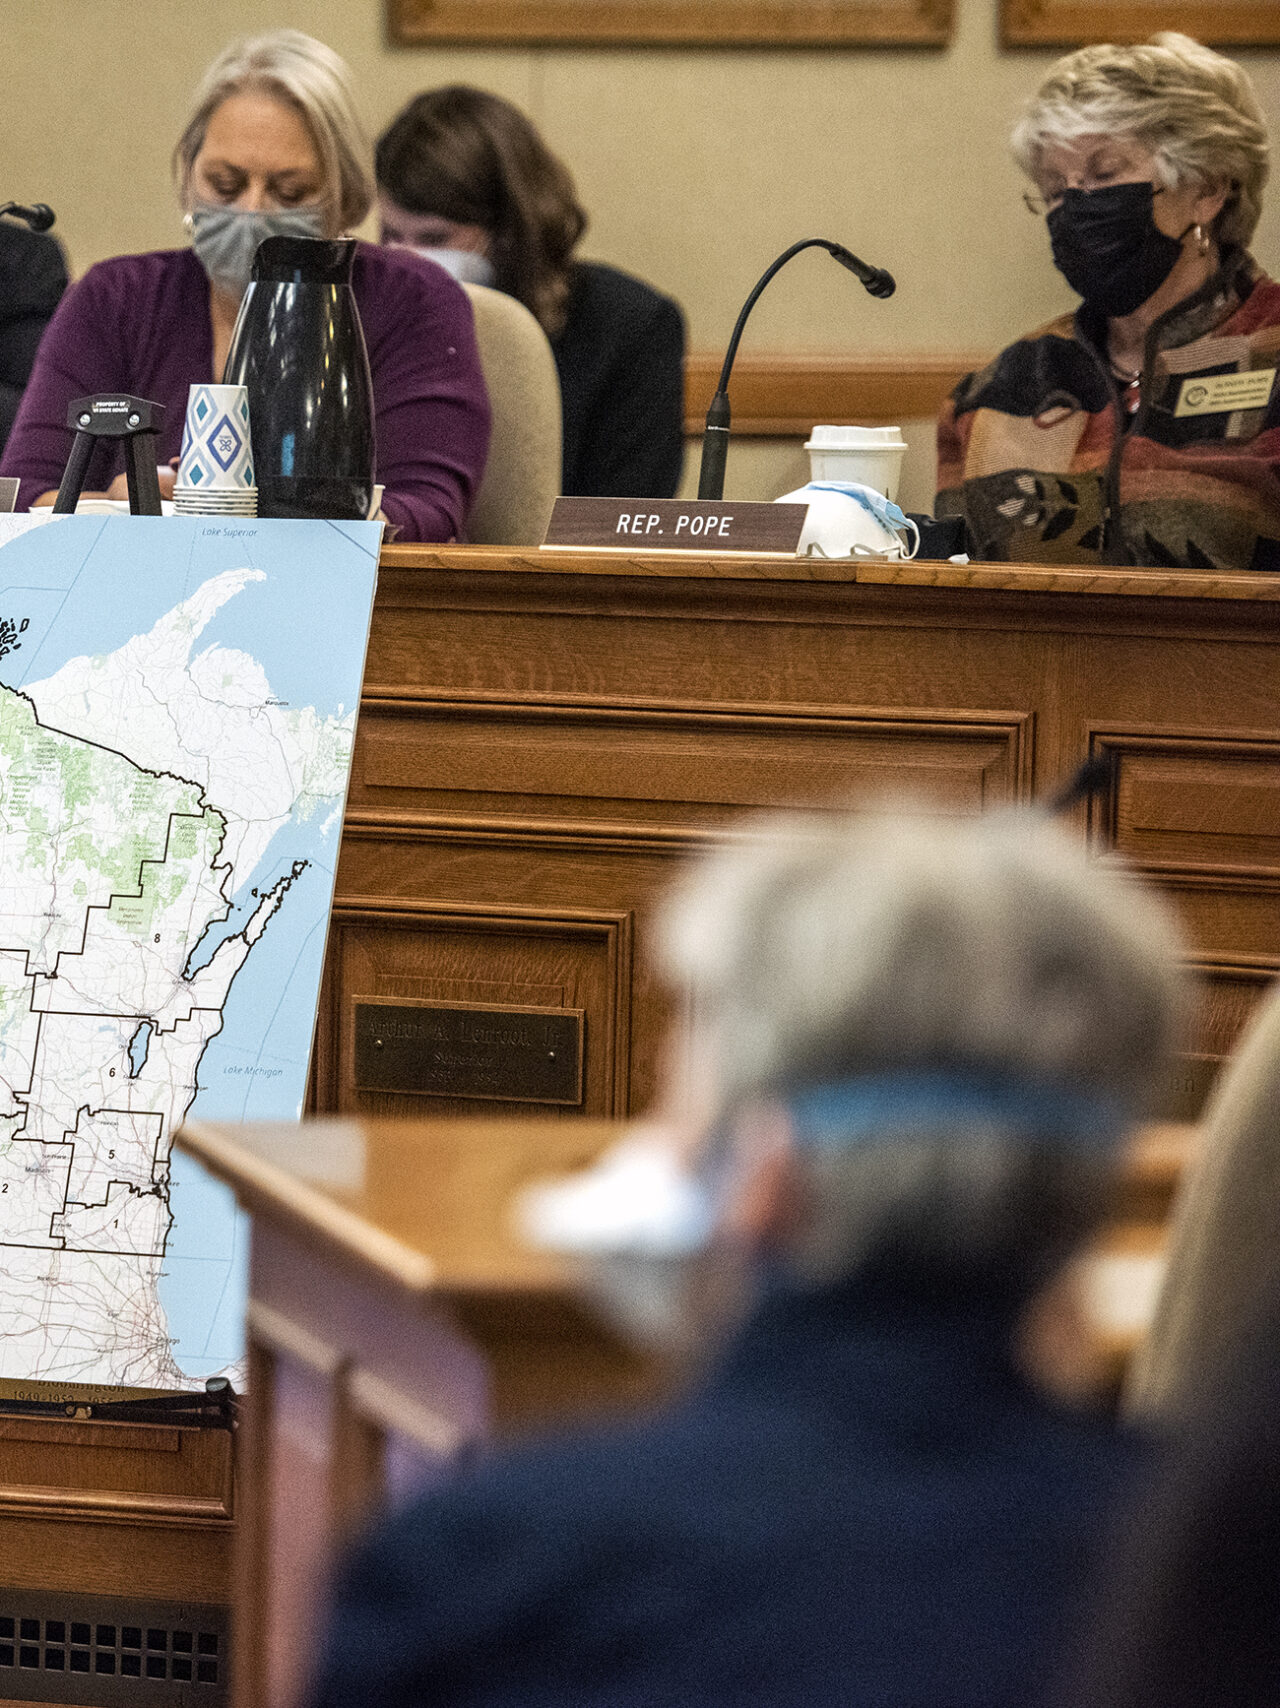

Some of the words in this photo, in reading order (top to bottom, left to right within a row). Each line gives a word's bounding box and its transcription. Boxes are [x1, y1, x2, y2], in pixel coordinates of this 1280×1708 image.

[616, 513, 664, 535] REP.
[675, 515, 734, 537] POPE
[201, 527, 221, 536] Lake
[222, 527, 258, 539] Superior
[154, 933, 161, 944] 8
[109, 1067, 116, 1078] 6
[223, 1065, 243, 1074] Lake
[244, 1065, 283, 1079] Michigan
[108, 1149, 115, 1160] 5
[1, 1183, 9, 1194] 2
[113, 1218, 119, 1229] 1
